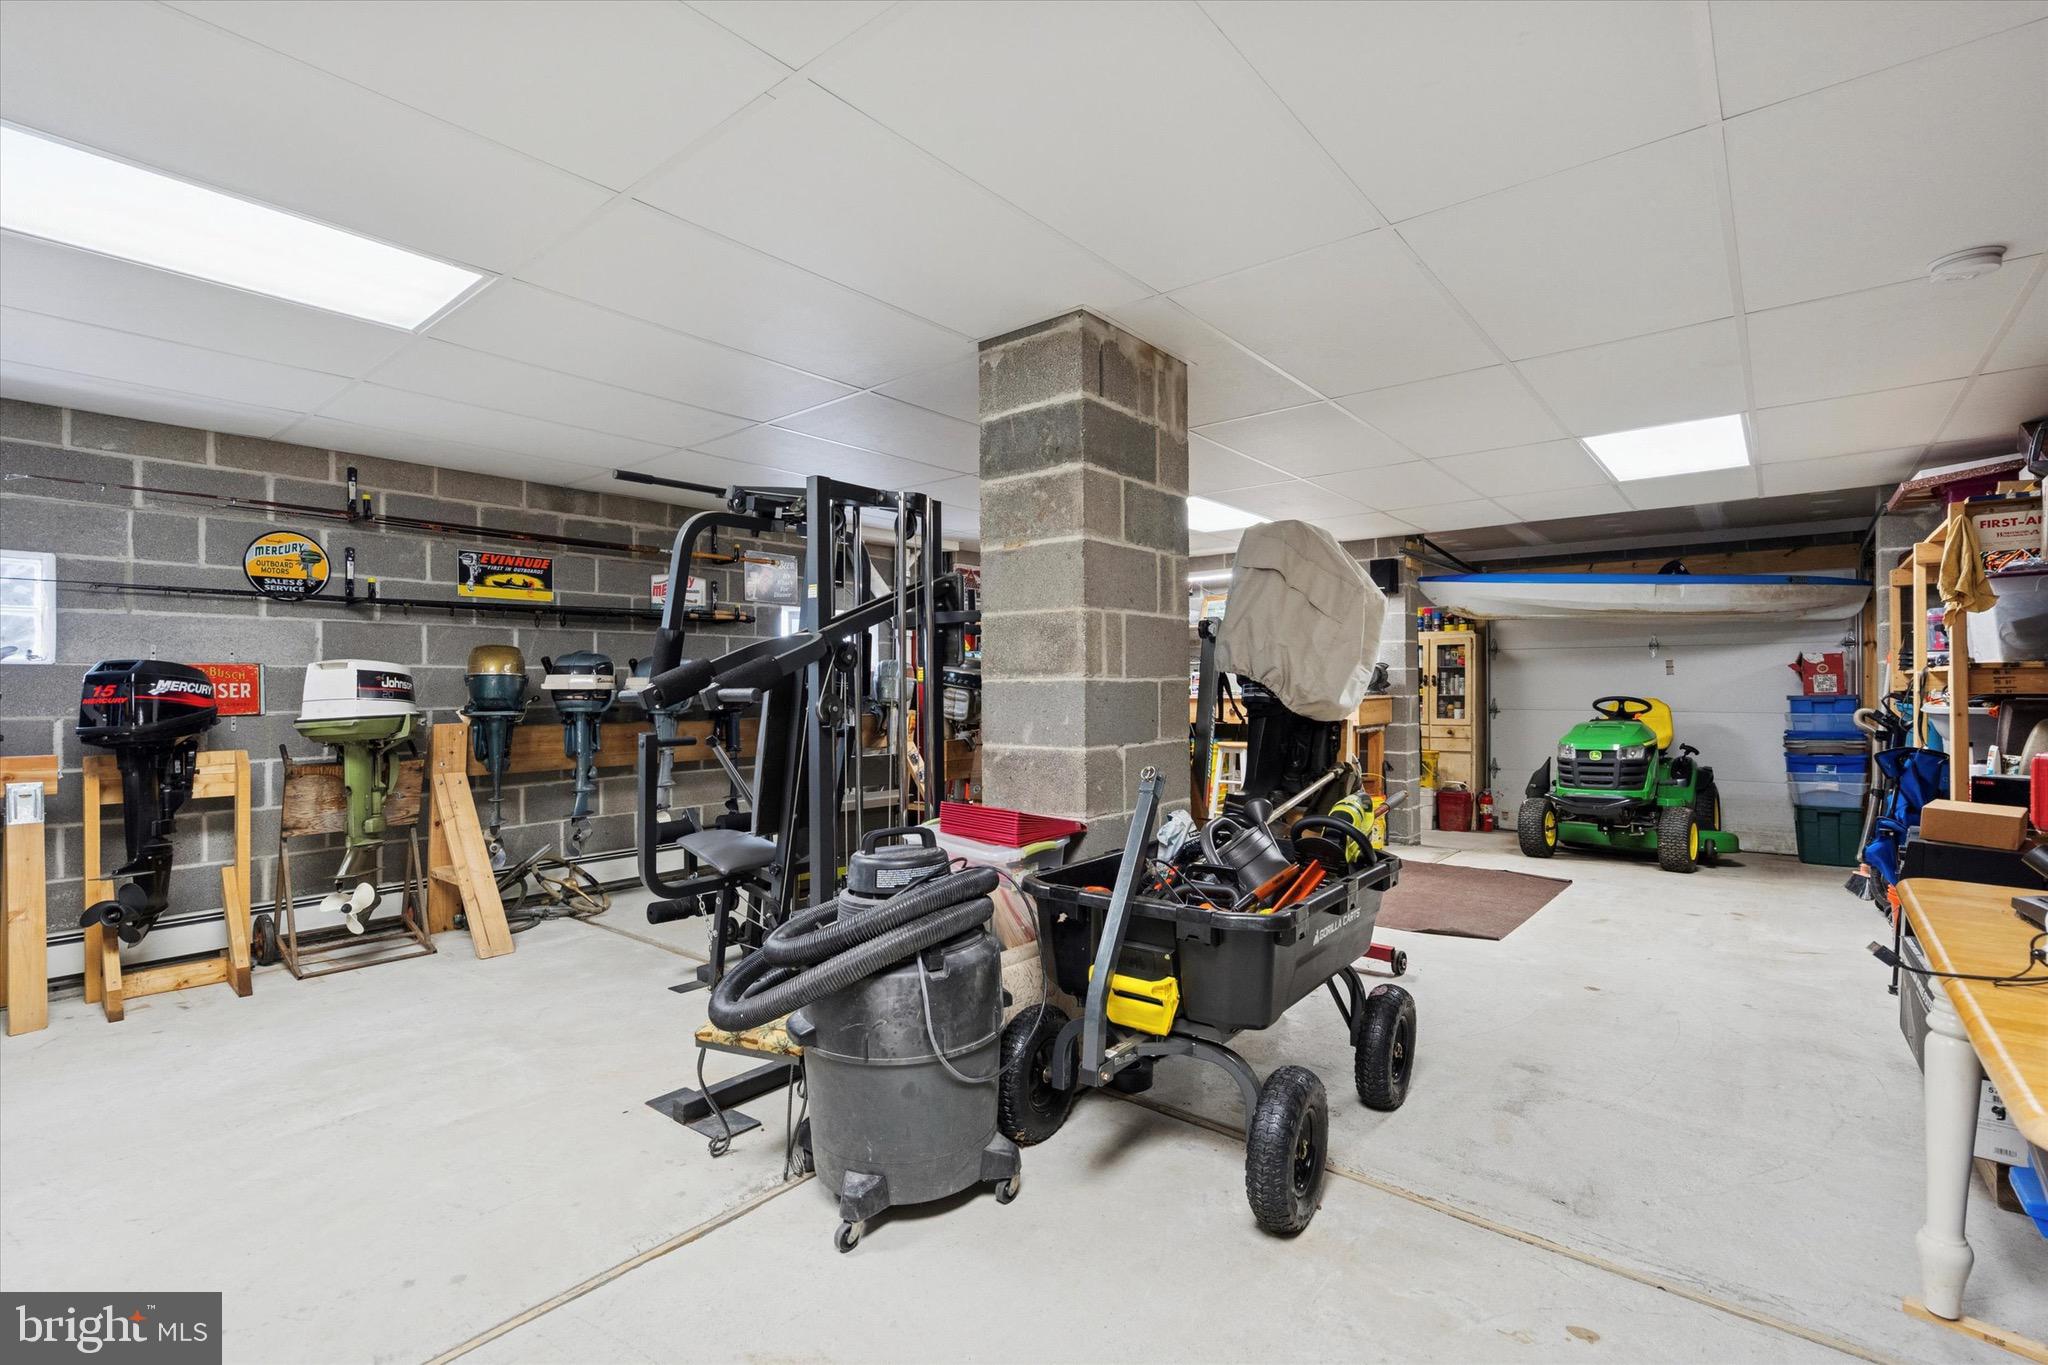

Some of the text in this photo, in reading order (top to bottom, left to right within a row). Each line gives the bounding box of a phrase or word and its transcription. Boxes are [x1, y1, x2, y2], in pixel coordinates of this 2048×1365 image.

[1980, 515, 2042, 529] FIRST-AI
[255, 543, 304, 556] MERCURY
[256, 560, 294, 569] OUTBOARD
[480, 553, 550, 569] EVINRUDE
[513, 566, 544, 575] OUTBOARDS
[264, 578, 294, 586] SALES
[156, 679, 213, 695] MERCURY
[82, 697, 129, 705] MERCURY
